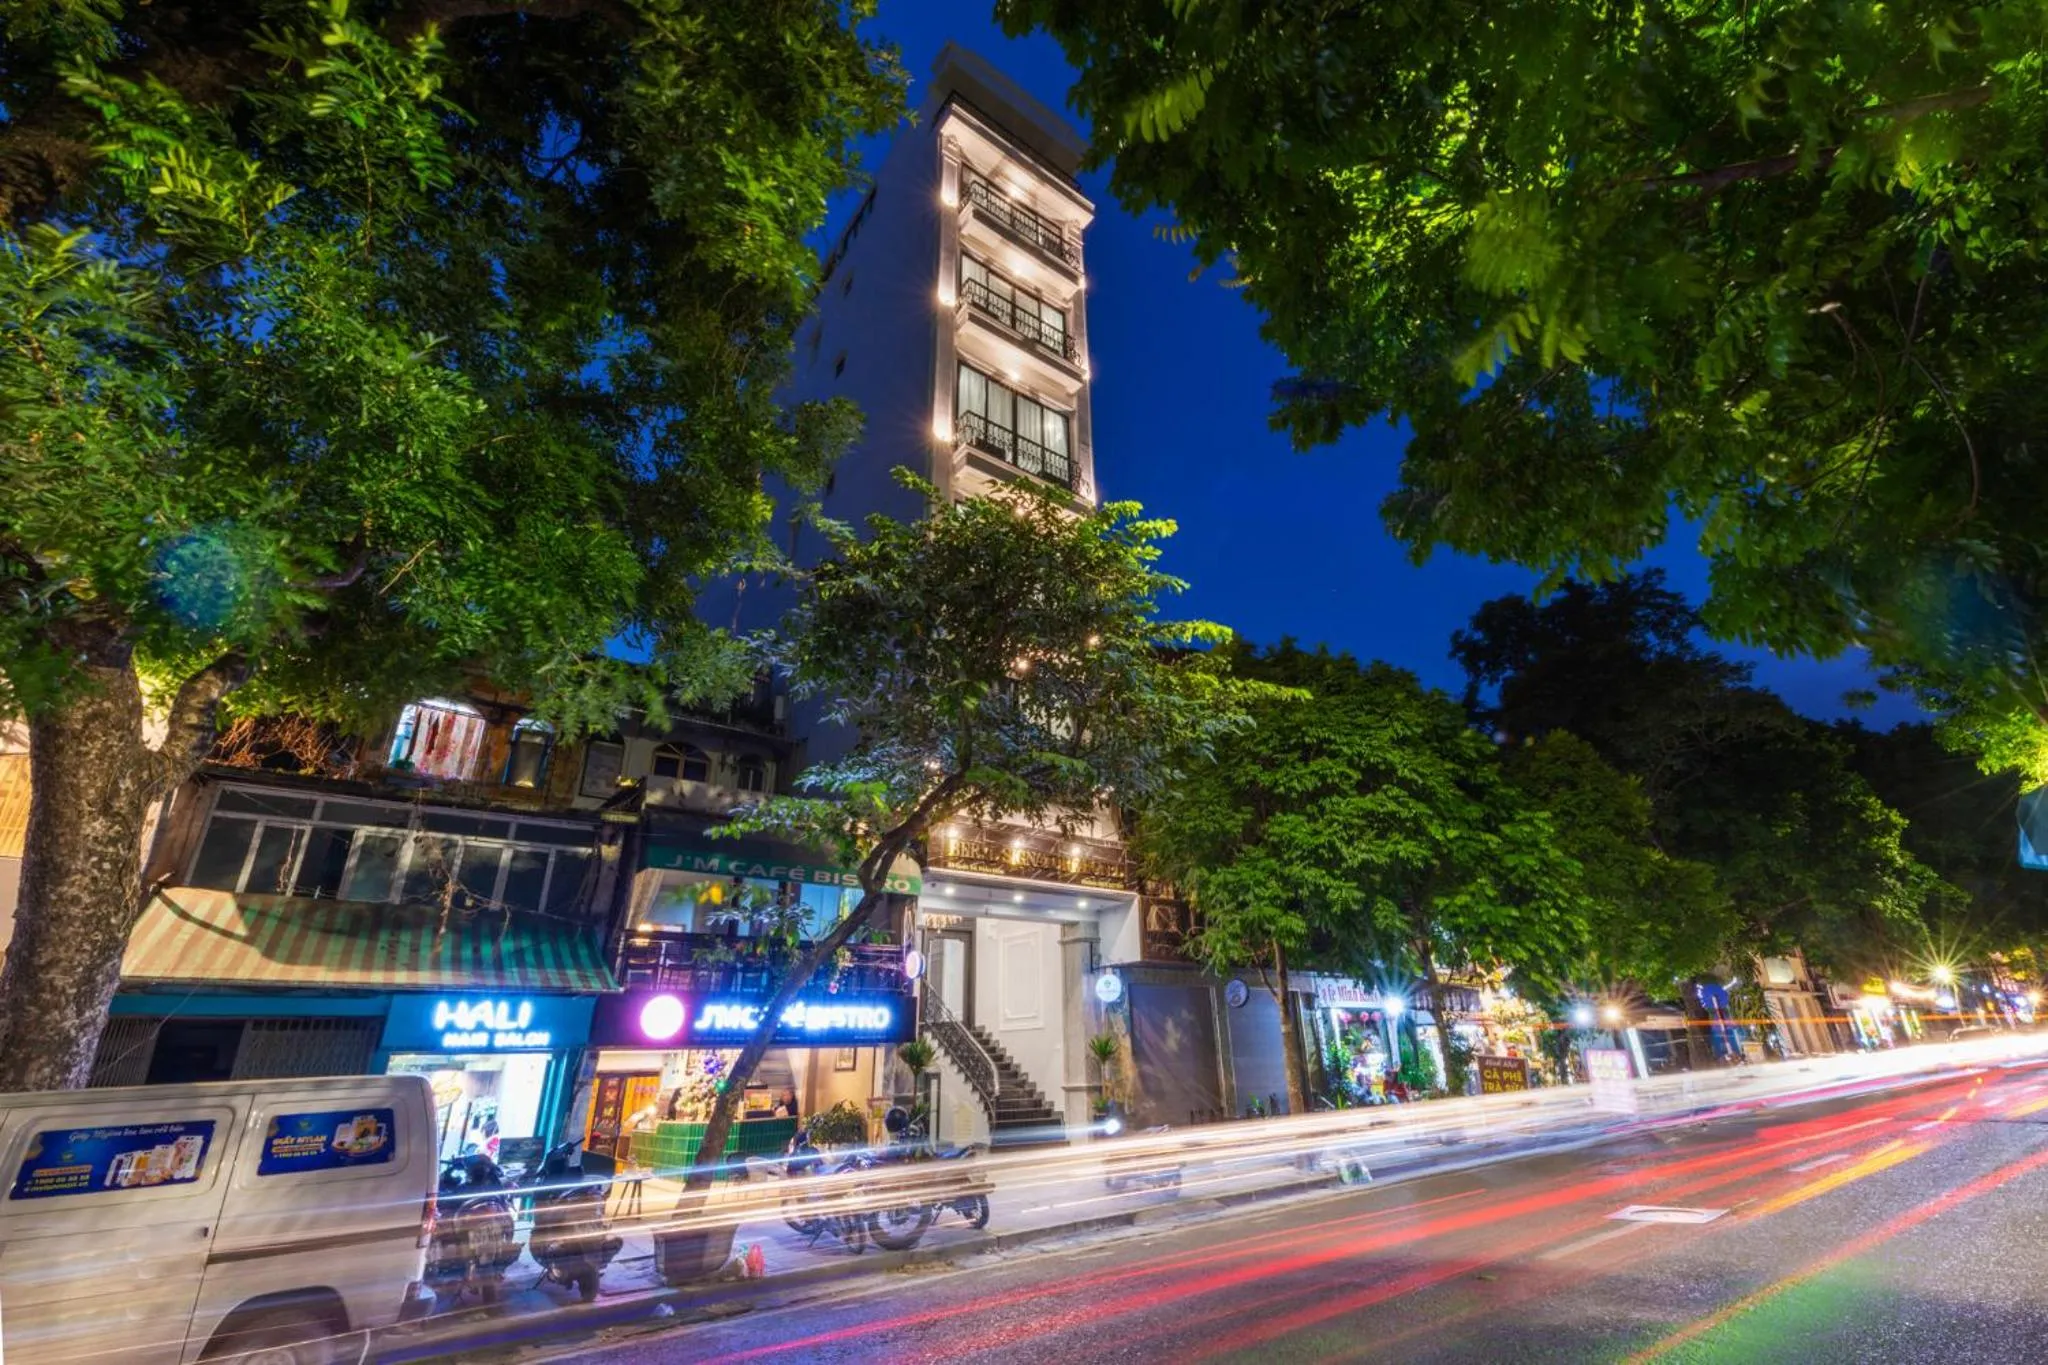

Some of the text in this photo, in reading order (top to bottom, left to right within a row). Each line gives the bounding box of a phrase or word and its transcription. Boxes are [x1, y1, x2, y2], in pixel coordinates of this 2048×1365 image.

[666, 854, 912, 893] J'M CAFÉ BISRO
[433, 1000, 533, 1031] HALI
[741, 1001, 806, 1030] CFÉ
[806, 1006, 890, 1031] BISTRO
